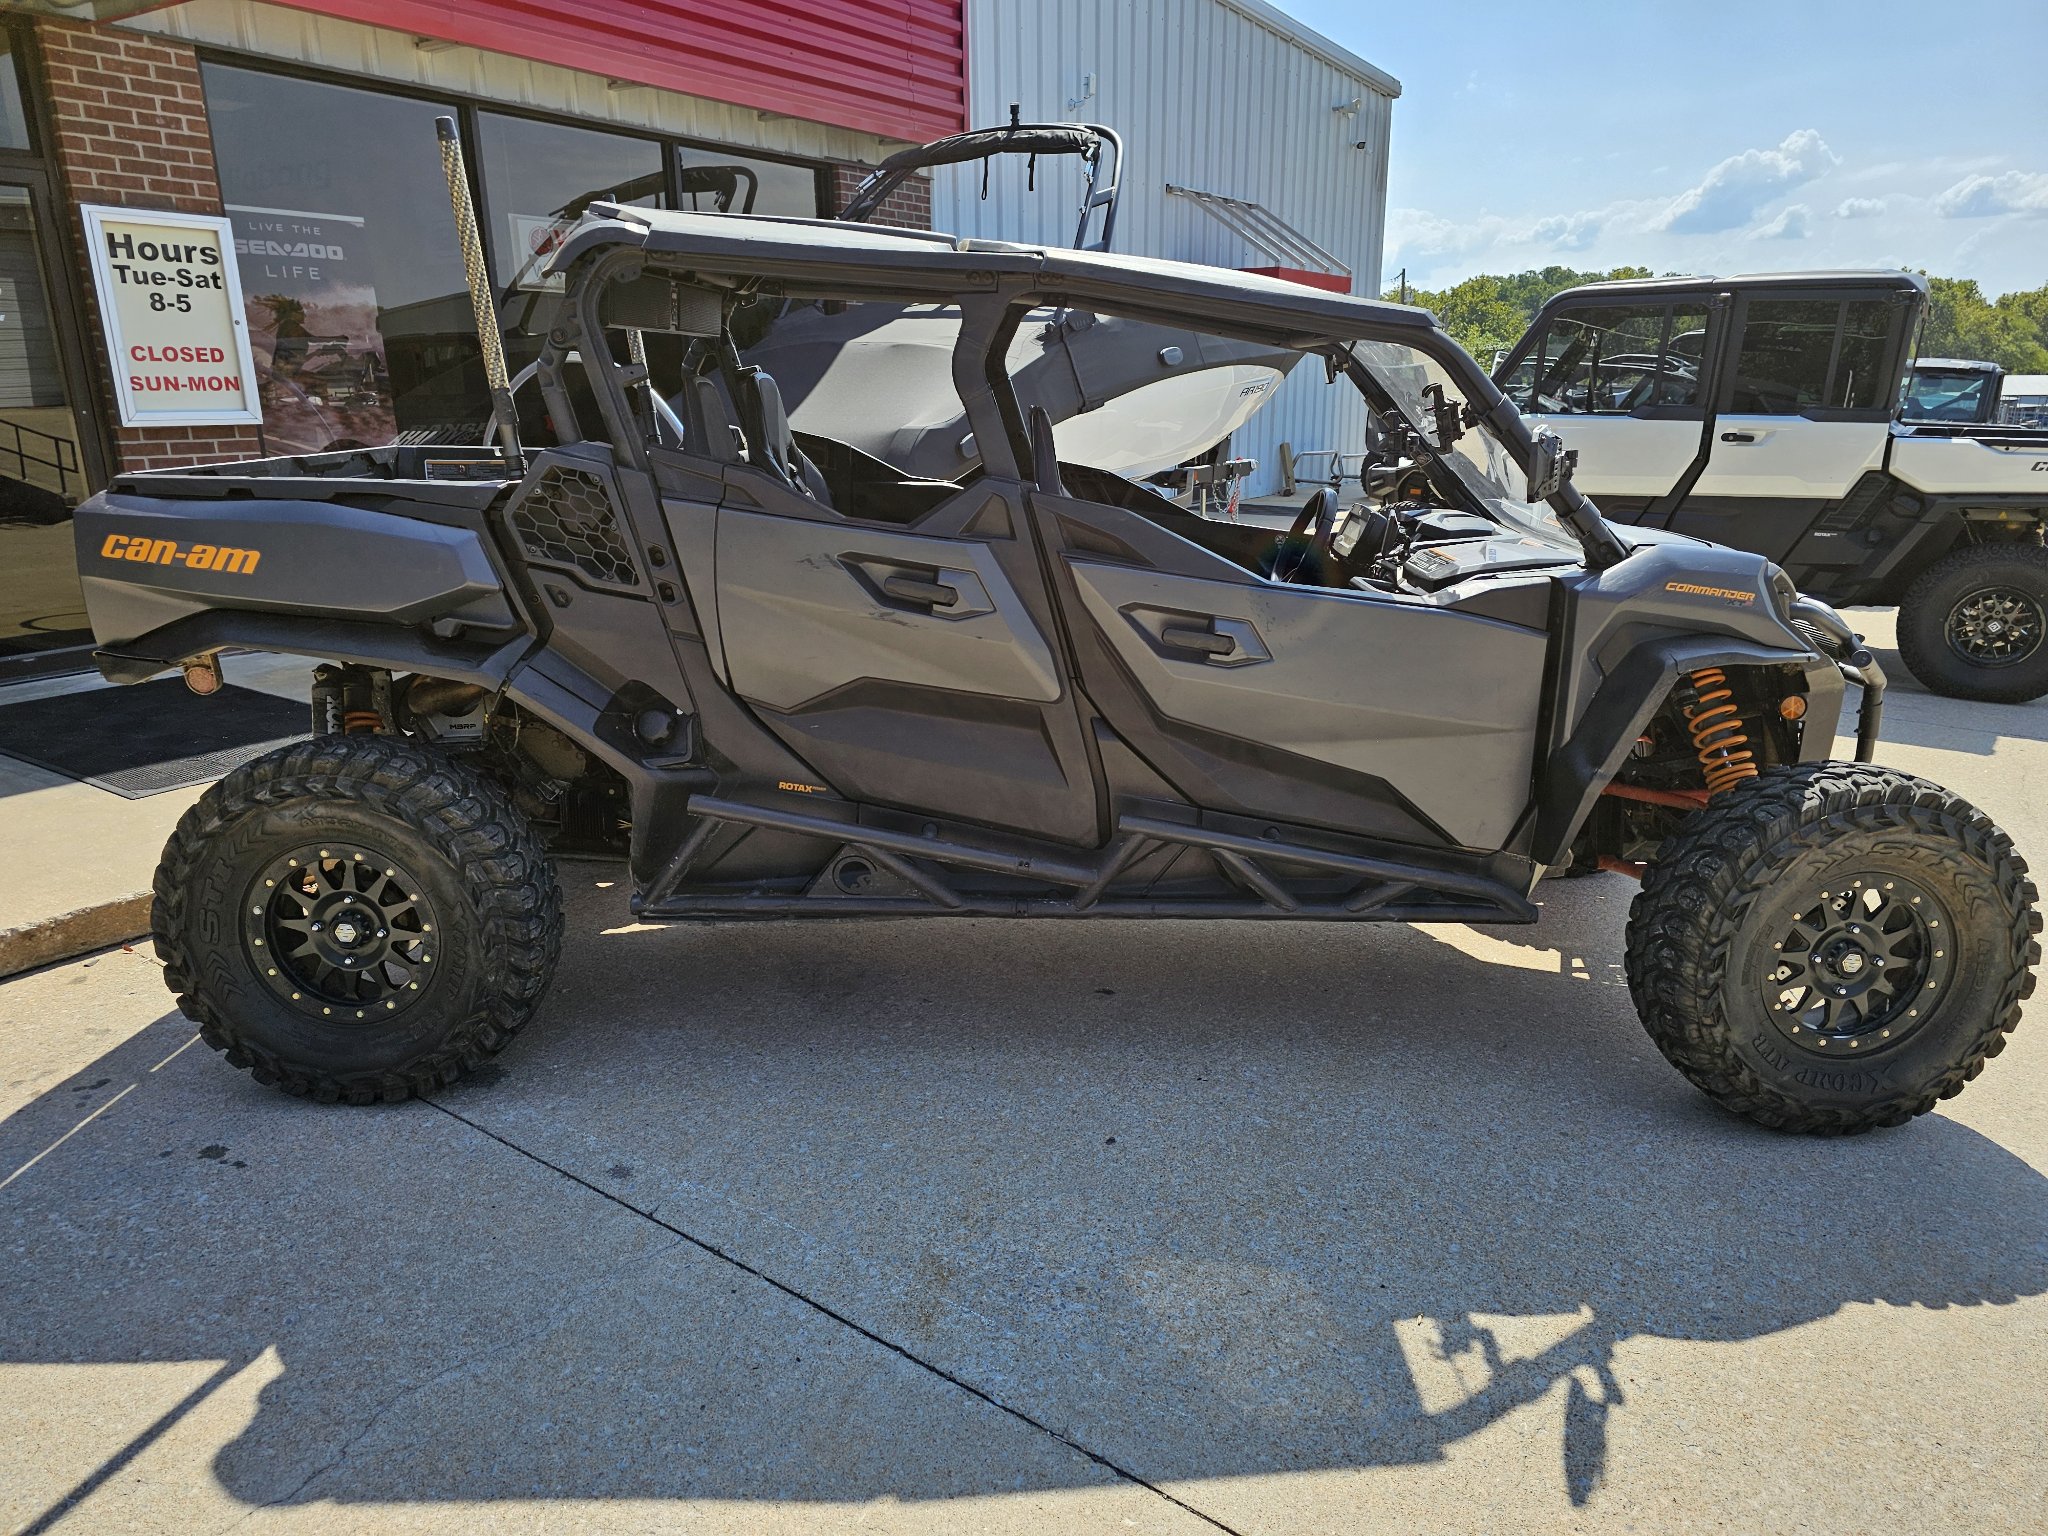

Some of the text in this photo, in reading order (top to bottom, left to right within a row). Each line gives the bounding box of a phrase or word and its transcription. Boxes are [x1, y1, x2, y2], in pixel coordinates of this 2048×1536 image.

[249, 222, 320, 235] LIVE THE
[106, 232, 219, 265] Hours
[112, 264, 222, 290] Tue-Sat
[265, 265, 320, 280] LIFE
[150, 292, 192, 313] 8-5
[130, 345, 225, 363] CLOSED
[130, 376, 240, 391] SUN-MON
[101, 534, 261, 575] can-am
[1665, 582, 1755, 601] COMMANDER
[778, 781, 812, 793] ROTAX
